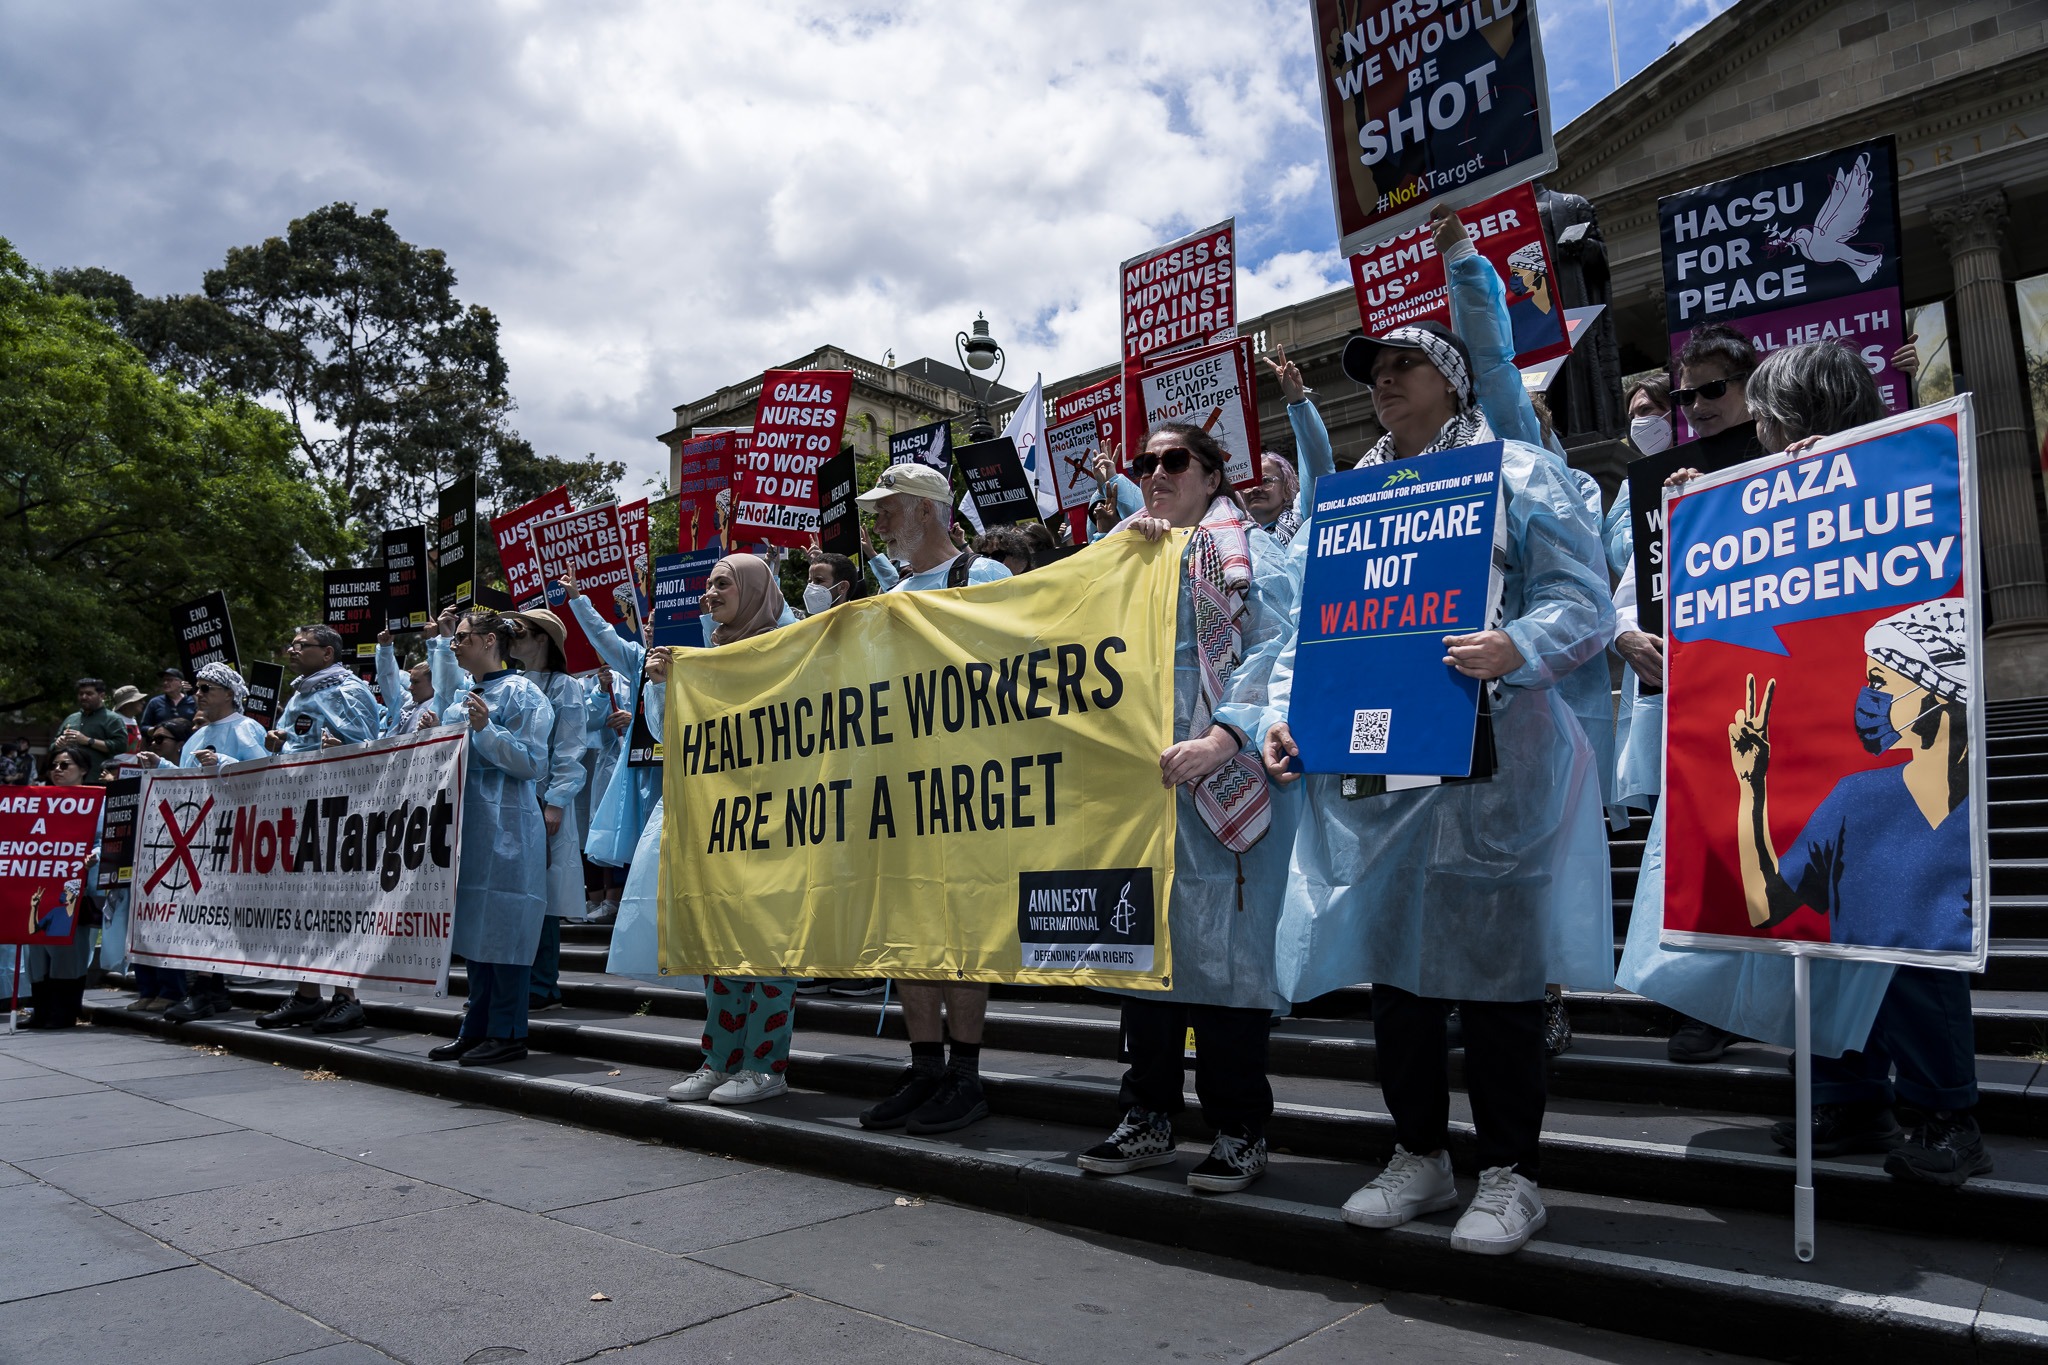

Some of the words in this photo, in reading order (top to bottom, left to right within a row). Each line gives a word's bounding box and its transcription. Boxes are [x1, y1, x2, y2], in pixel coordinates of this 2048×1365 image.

[1342, 0, 1457, 63] NURS
[1335, 54, 1384, 101] WE
[1387, 0, 1519, 73] WOULD
[1408, 58, 1440, 93] BE
[1358, 60, 1497, 166] SHOT
[1376, 152, 1485, 214] #NotATarget
[1673, 181, 1804, 243] HACSU
[1126, 243, 1209, 292] NURSES
[1214, 235, 1231, 258] &
[1676, 237, 1753, 281] FOR
[1126, 259, 1231, 314] MIDWIVES
[1678, 263, 1807, 320] PEACE
[1126, 282, 1230, 336] AGAINST
[1368, 310, 1386, 323] DR
[1386, 284, 1448, 316] MAHMOUD
[1371, 317, 1395, 333] ABU
[1397, 300, 1446, 324] NUJAILA
[1786, 309, 1890, 346] HEALTH
[1127, 306, 1229, 357] TORTURE
[1156, 358, 1222, 391] REFUGEE
[1165, 374, 1218, 401] CAMPS
[1060, 387, 1112, 419] NURSES
[1148, 385, 1241, 423] #NotATarget
[761, 406, 837, 428] NURSES
[714, 436, 726, 451] OF
[806, 435, 831, 451] GO
[892, 433, 928, 453] HACSU
[1050, 420, 1095, 444] DOCTORS
[706, 457, 720, 472] WE
[748, 451, 770, 471] TO
[706, 475, 729, 489] WITH
[966, 468, 981, 480] WE
[971, 480, 985, 493] SAY
[986, 477, 1001, 490] WE
[1741, 452, 1857, 516] GAZA
[756, 476, 778, 496] TO
[781, 478, 813, 499] DIE
[831, 479, 850, 502] HEALTH
[1003, 487, 1026, 501] KNOW
[1317, 498, 1346, 513] MEDICAL
[1347, 488, 1394, 508] ASSOCIATION
[1394, 486, 1410, 498] FOR
[1411, 477, 1460, 496] PREVENTION
[1461, 475, 1472, 487] OF
[1474, 471, 1494, 484] WAR
[454, 508, 467, 524] GAZA
[737, 503, 822, 531] #NotATarget
[822, 501, 847, 525] WORKERS
[543, 511, 609, 543] NURSES
[597, 526, 619, 546] BE
[1316, 501, 1485, 558] HEALTHCARE
[1685, 517, 1796, 578] CODE
[1807, 483, 1934, 549] BLUE
[387, 542, 408, 555] HEALTH
[440, 530, 459, 550] HEALTH
[388, 555, 415, 570] WORKERS
[440, 545, 465, 568] WORKERS
[389, 571, 400, 583] ARE
[508, 561, 527, 582] DR
[547, 585, 566, 599] STOP
[577, 567, 629, 592] ENOCIDE
[1363, 552, 1418, 591] NOT
[1675, 535, 1956, 629] EMERGENCY
[329, 581, 381, 595] HEALTHCARE
[189, 606, 209, 622] END
[329, 596, 369, 608] WORKERS
[656, 597, 677, 609] ATTACKS
[677, 597, 685, 607] ON
[1320, 589, 1462, 635] WARFARE
[329, 610, 346, 622] ARE
[188, 639, 208, 656] BAN
[209, 633, 223, 648] ON
[683, 680, 893, 777] HEALTHCARE
[903, 636, 1127, 739] WORKERS
[0, 797, 41, 814] ARE
[46, 797, 95, 815] YOU
[707, 791, 771, 854] ARE
[785, 779, 852, 848] NOT
[869, 775, 896, 840] A
[907, 751, 1063, 837] TARGET
[30, 817, 47, 835] A
[107, 809, 133, 825] WORKERS
[105, 826, 116, 839] ARE
[210, 788, 453, 894] #NotATarget
[0, 841, 87, 857] ENOCIDE
[0, 860, 84, 878] ENIER?
[1028, 888, 1097, 912] AMNESTY
[137, 901, 177, 923] ANMF
[178, 903, 232, 931] NURSES,
[234, 906, 292, 931] MIDWIVES
[294, 908, 302, 931] &
[304, 909, 352, 934] CARERS
[354, 910, 376, 934] FOR
[375, 911, 451, 939] PALESTINE
[1029, 916, 1100, 931] INTERNATIONAL
[1034, 950, 1076, 962] DEFENDING
[1103, 951, 1134, 964] RIGHTS
